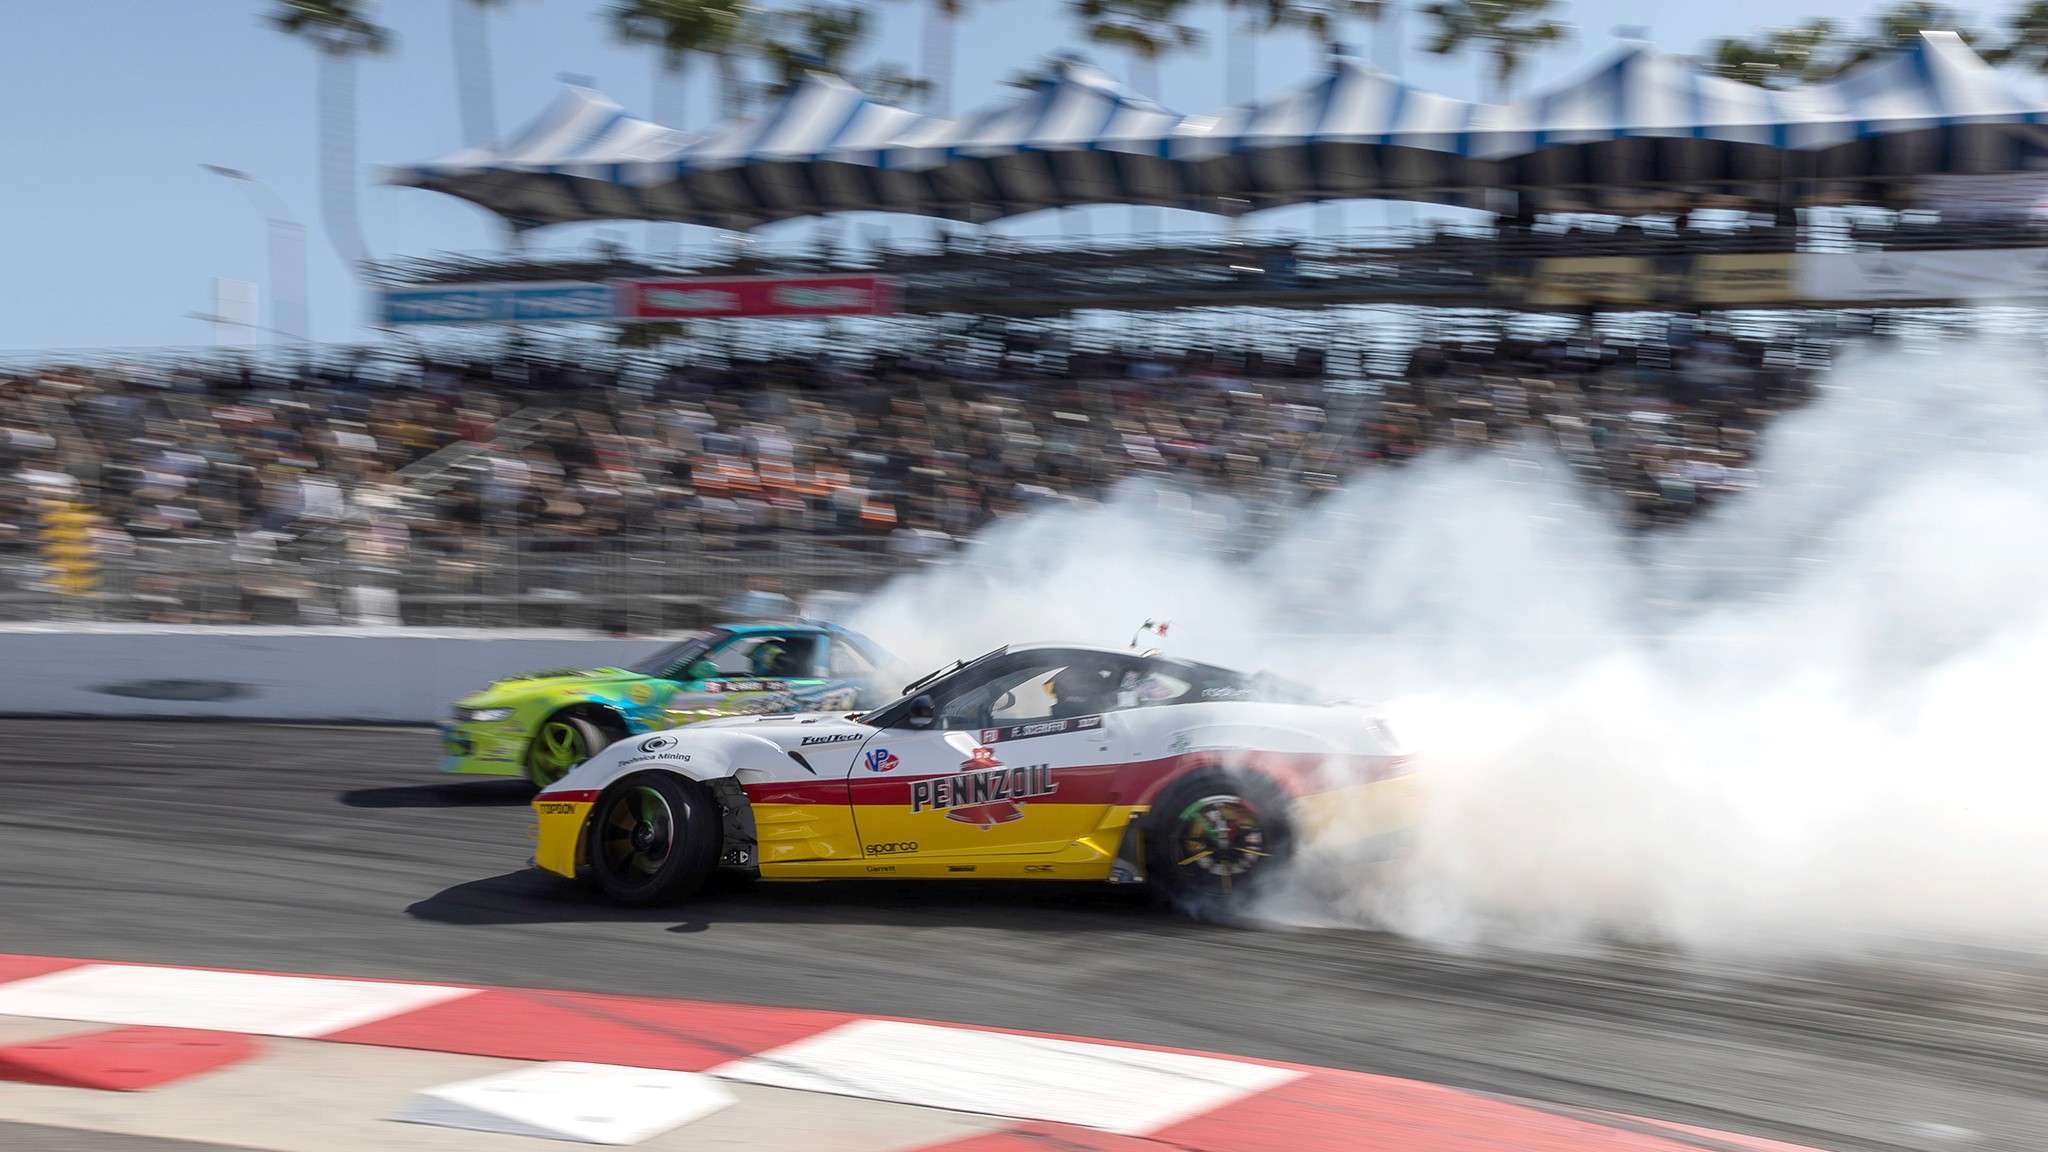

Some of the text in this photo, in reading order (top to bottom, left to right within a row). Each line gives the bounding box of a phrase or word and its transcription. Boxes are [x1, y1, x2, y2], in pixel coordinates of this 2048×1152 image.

[800, 733, 863, 747] FuelTech
[618, 752, 692, 767] Technica Mining
[866, 748, 889, 772] VP
[908, 763, 1060, 814] PENNZOIL
[866, 841, 918, 856] sparco
[866, 865, 896, 873] Garrett
